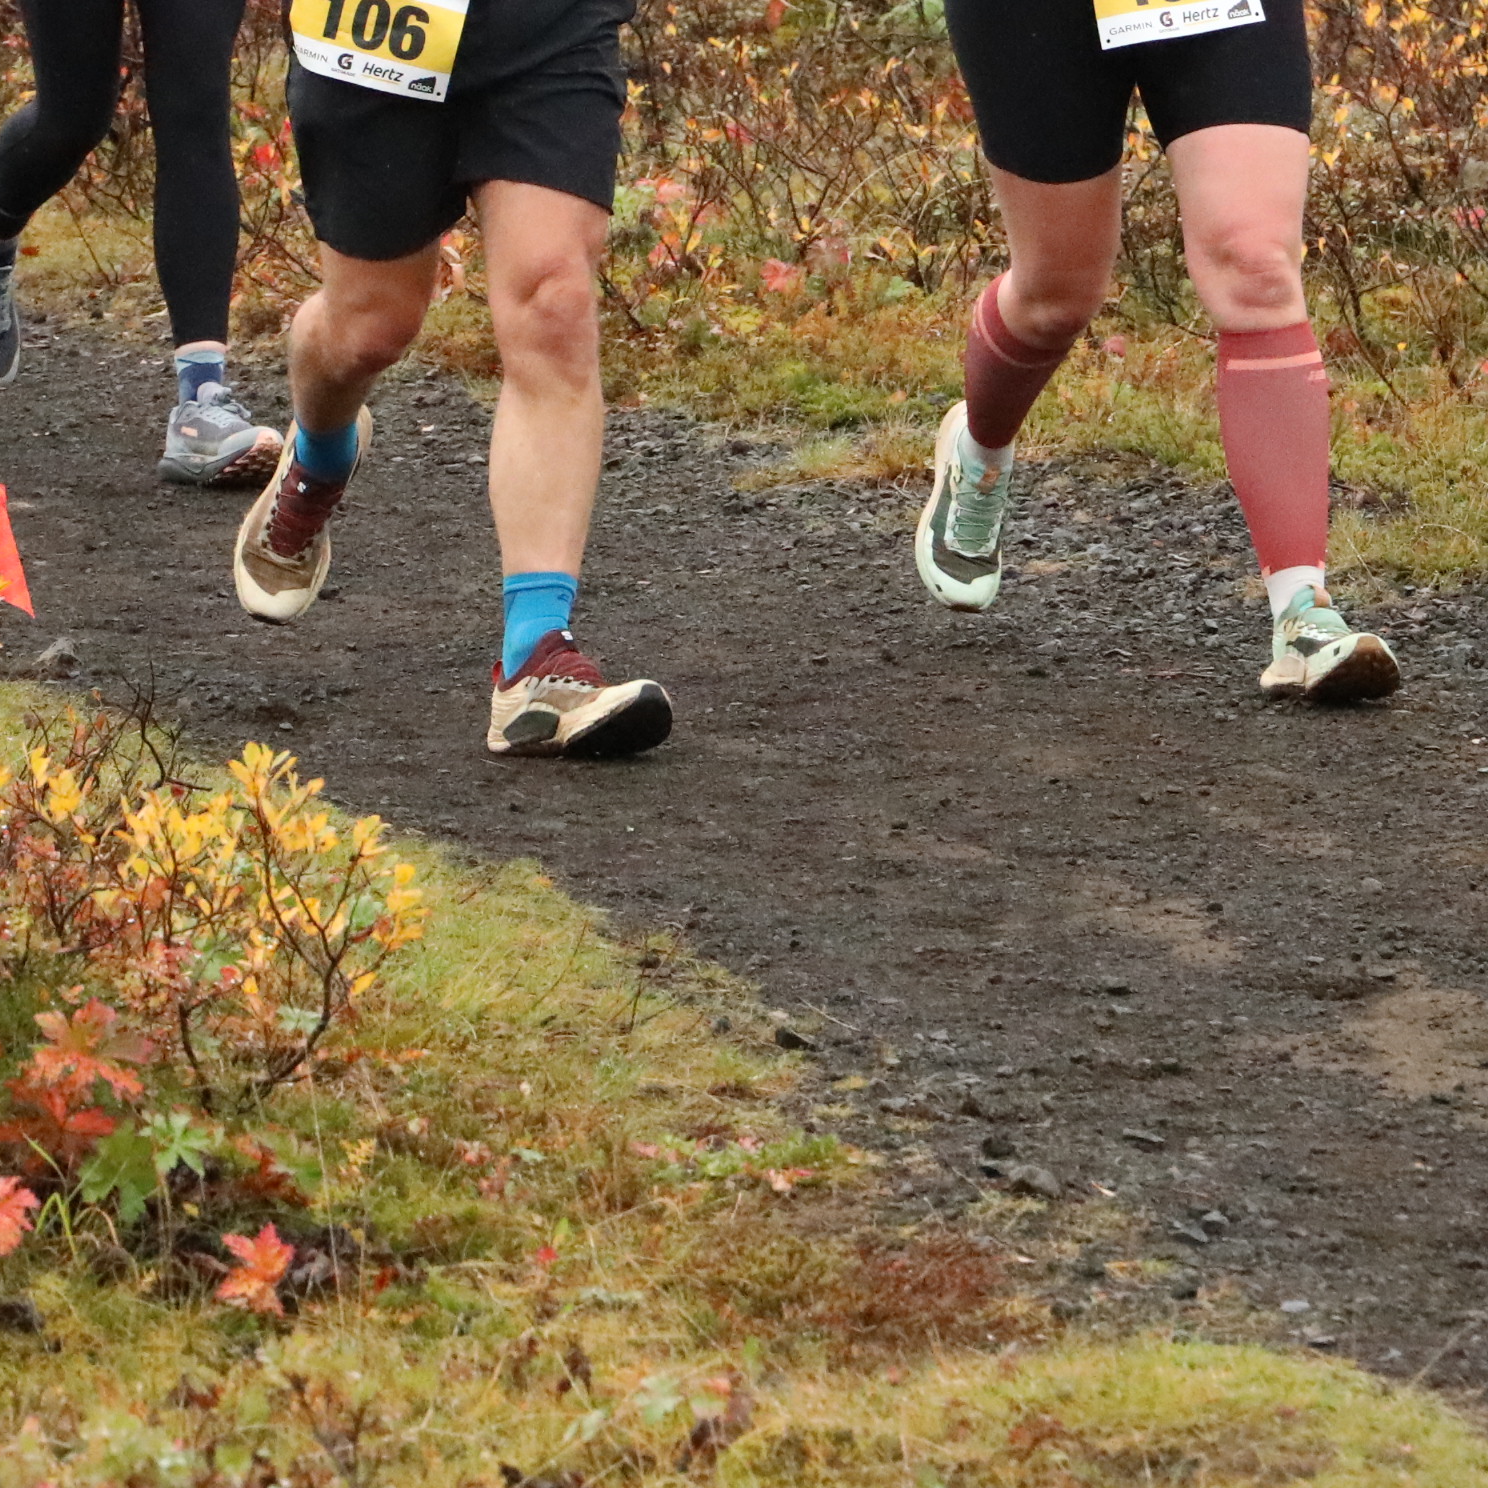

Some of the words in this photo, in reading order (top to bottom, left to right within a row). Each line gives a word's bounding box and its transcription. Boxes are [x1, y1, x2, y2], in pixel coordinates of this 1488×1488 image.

[1109, 21, 1154, 36] GARMIN
[1182, 7, 1220, 23] Hertz
[362, 61, 405, 83] Hertz
